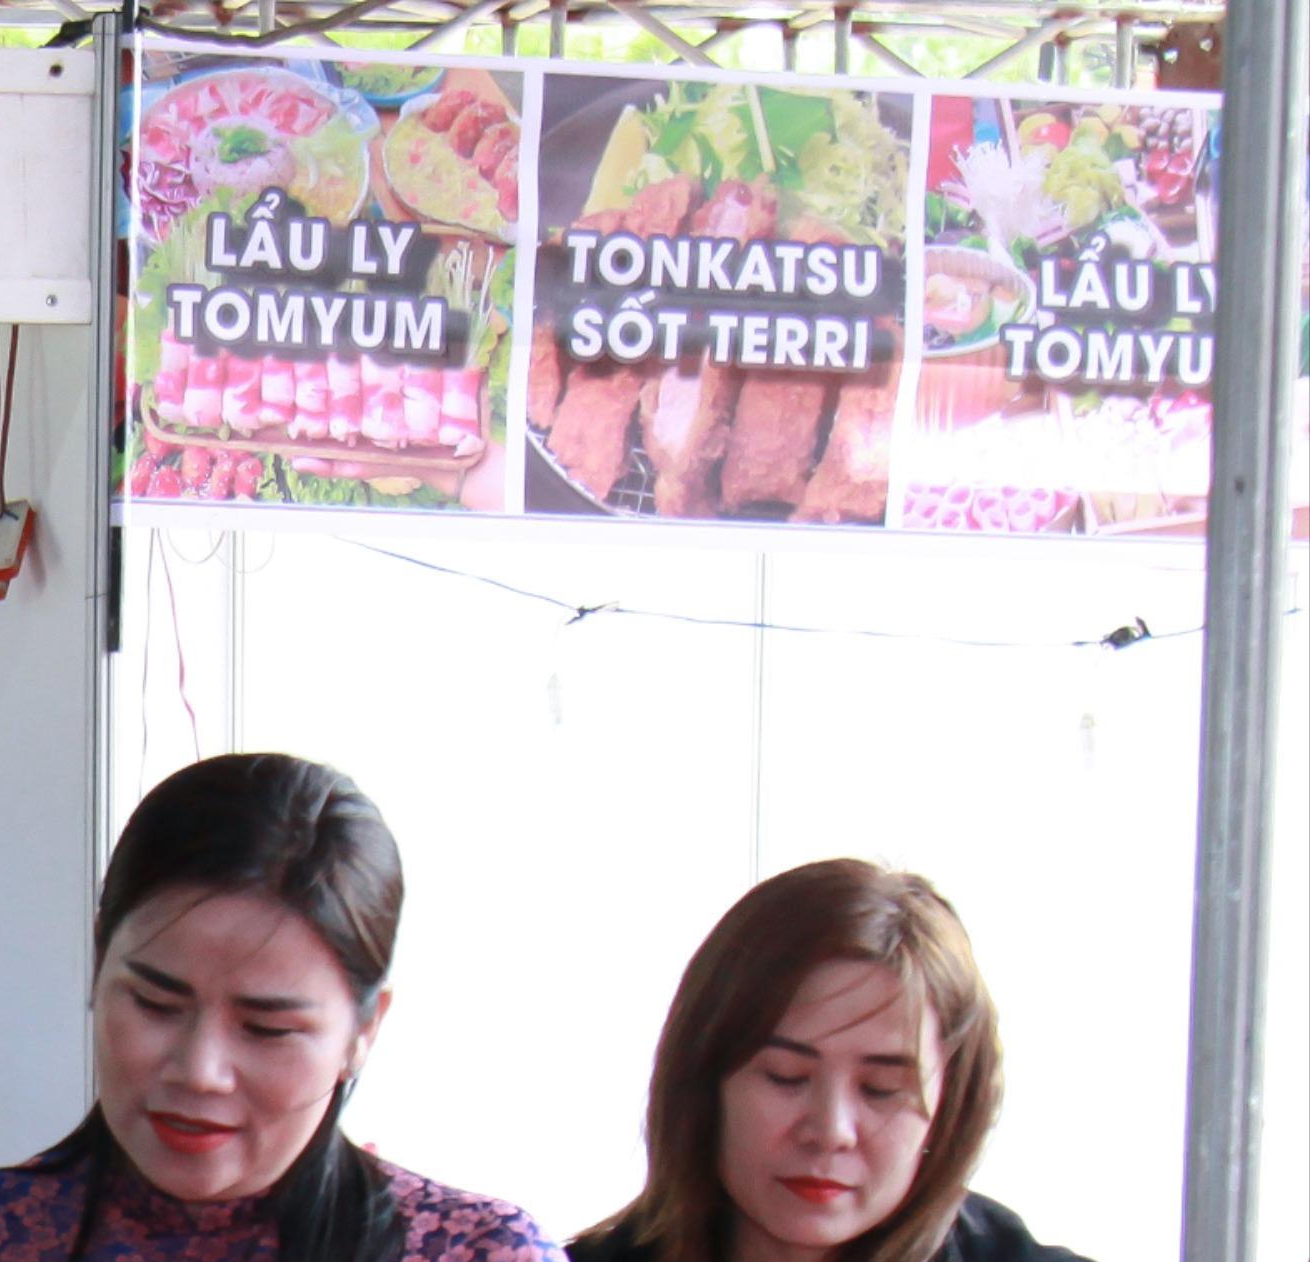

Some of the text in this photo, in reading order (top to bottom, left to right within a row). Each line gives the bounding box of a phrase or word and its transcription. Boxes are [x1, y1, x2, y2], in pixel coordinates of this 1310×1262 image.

[210, 192, 415, 275] LẨU LY
[567, 234, 878, 297] TONKATSU
[1041, 237, 1150, 311] LẨU
[172, 290, 443, 352] TOMYUM
[570, 291, 869, 369] SỐT TERRI
[1006, 329, 1213, 384] TOMYU
